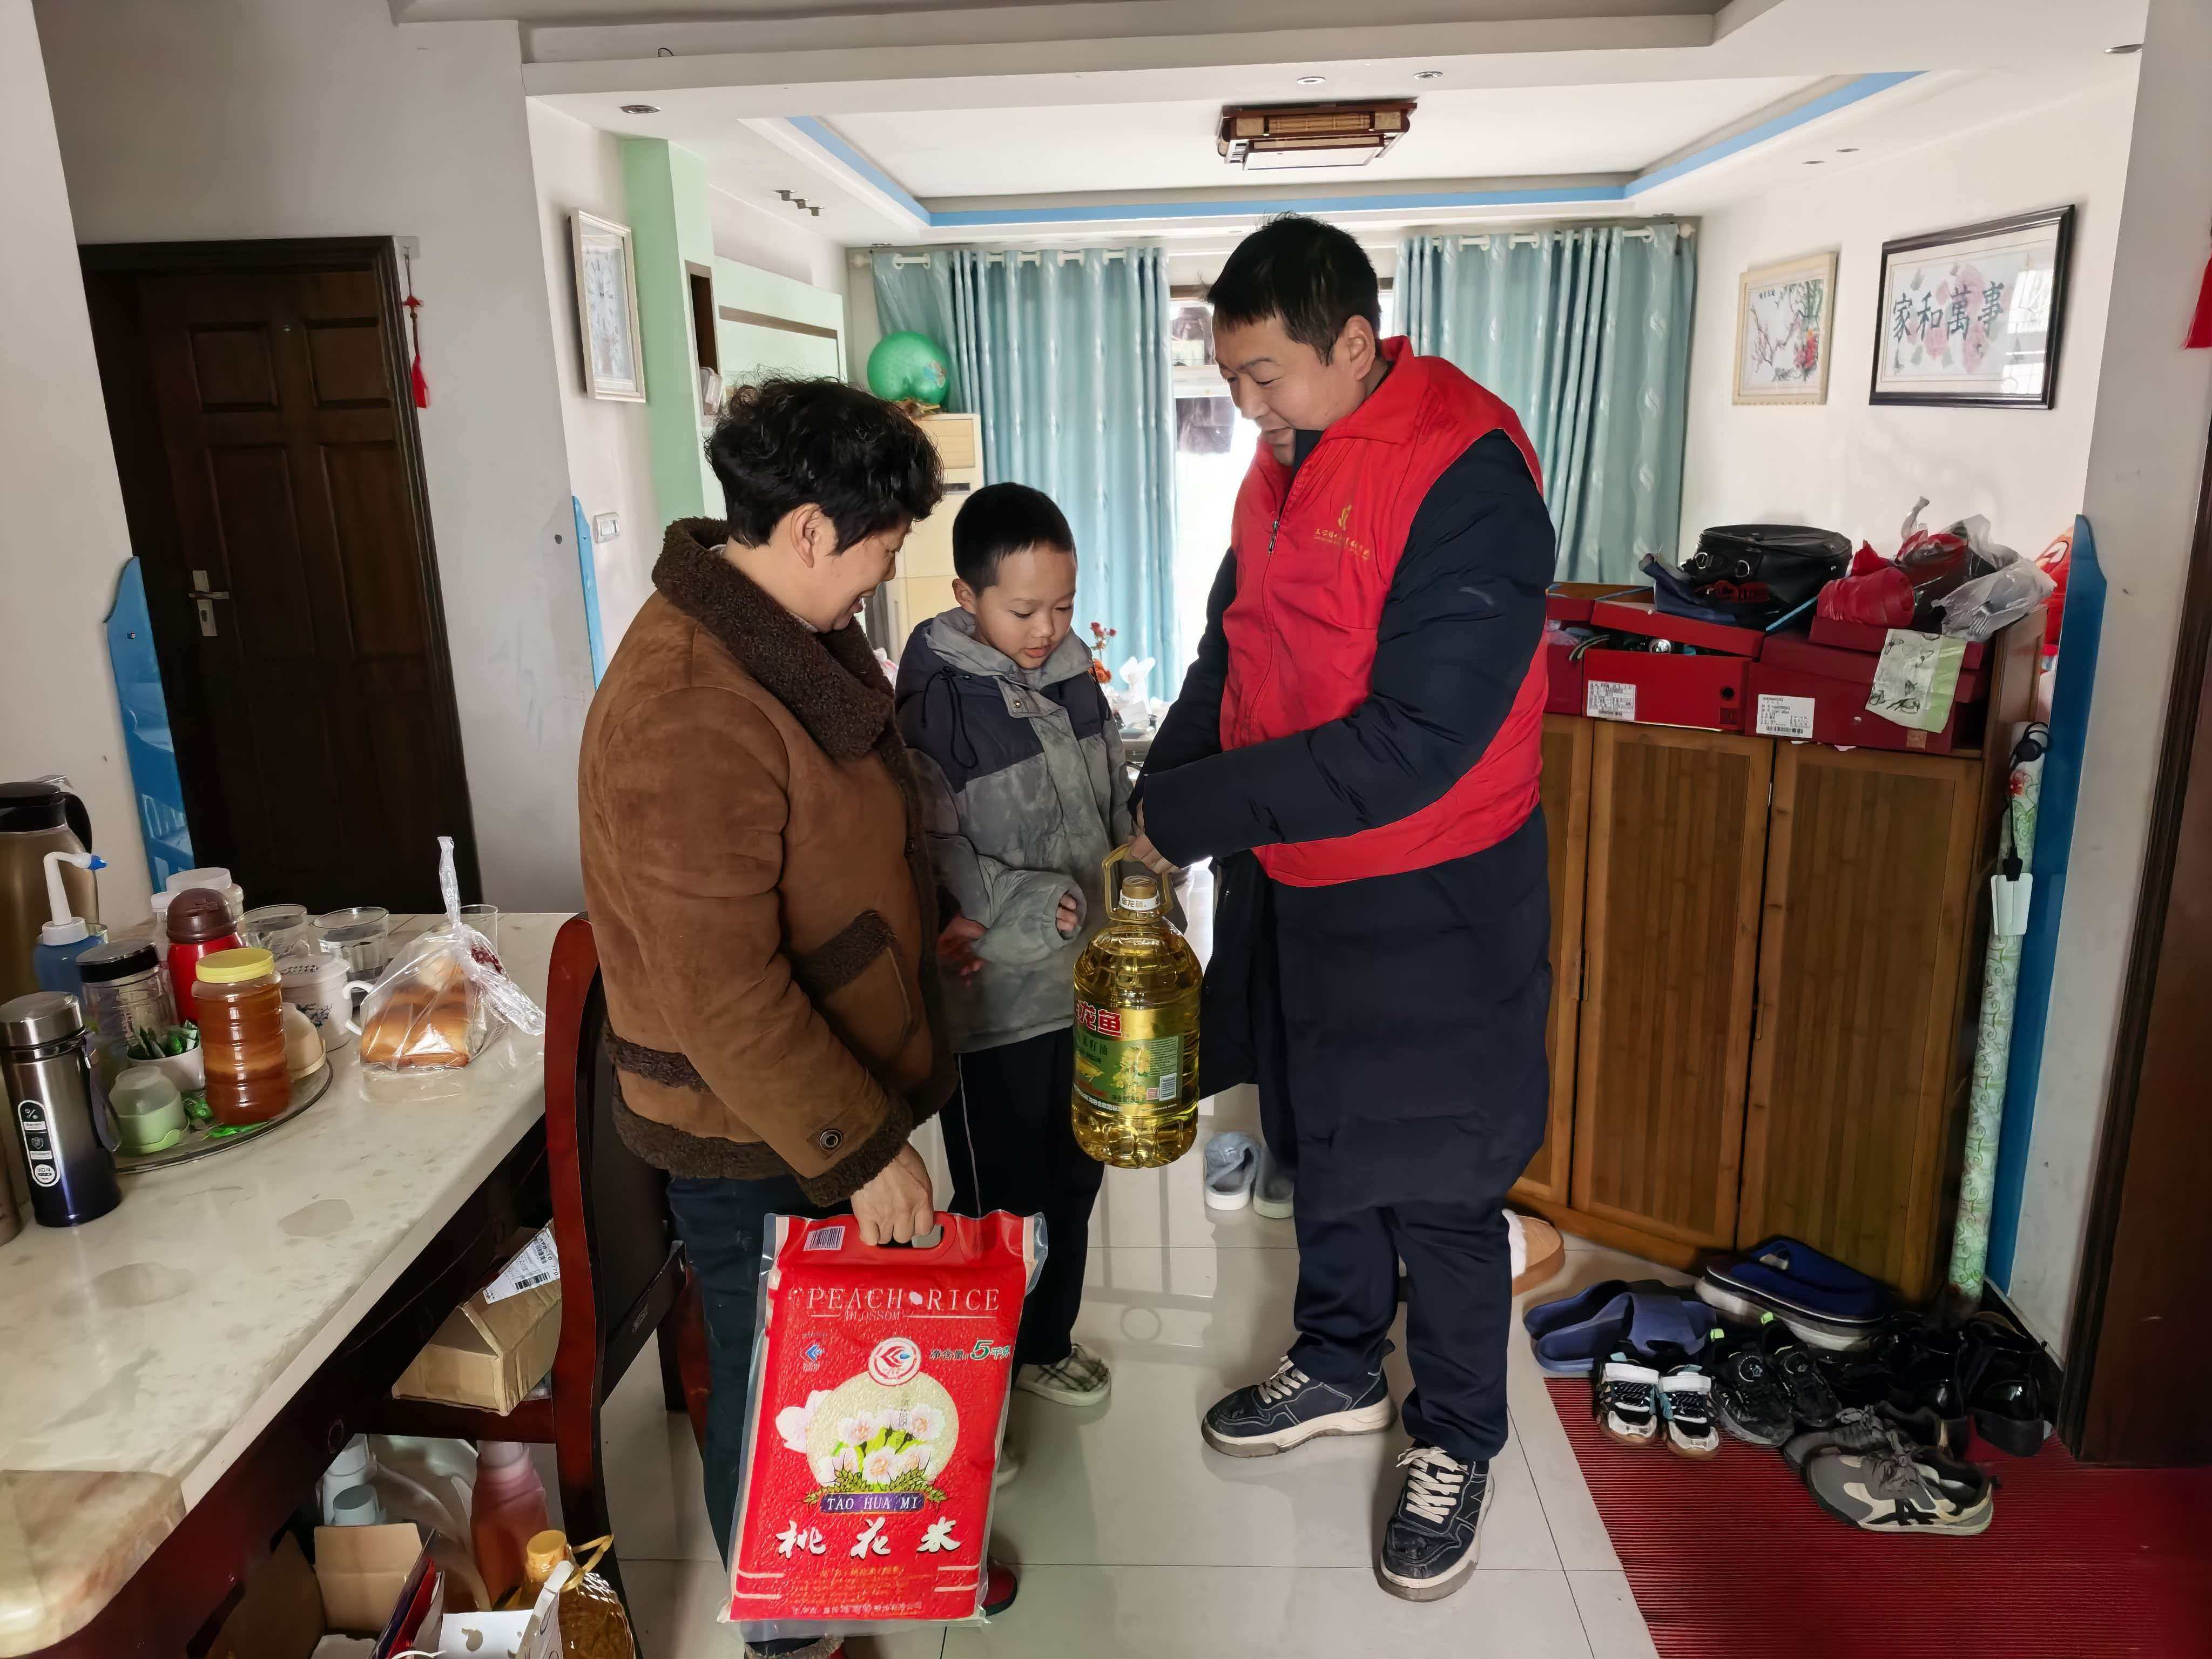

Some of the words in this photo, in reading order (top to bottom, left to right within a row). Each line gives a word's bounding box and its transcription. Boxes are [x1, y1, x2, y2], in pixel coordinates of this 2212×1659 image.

[807, 1287, 902, 1309] PEACH
[927, 1288, 999, 1311] RICE
[827, 1498, 854, 1510] TAO
[864, 1497, 891, 1510] HUA
[900, 1496, 919, 1509] MI
